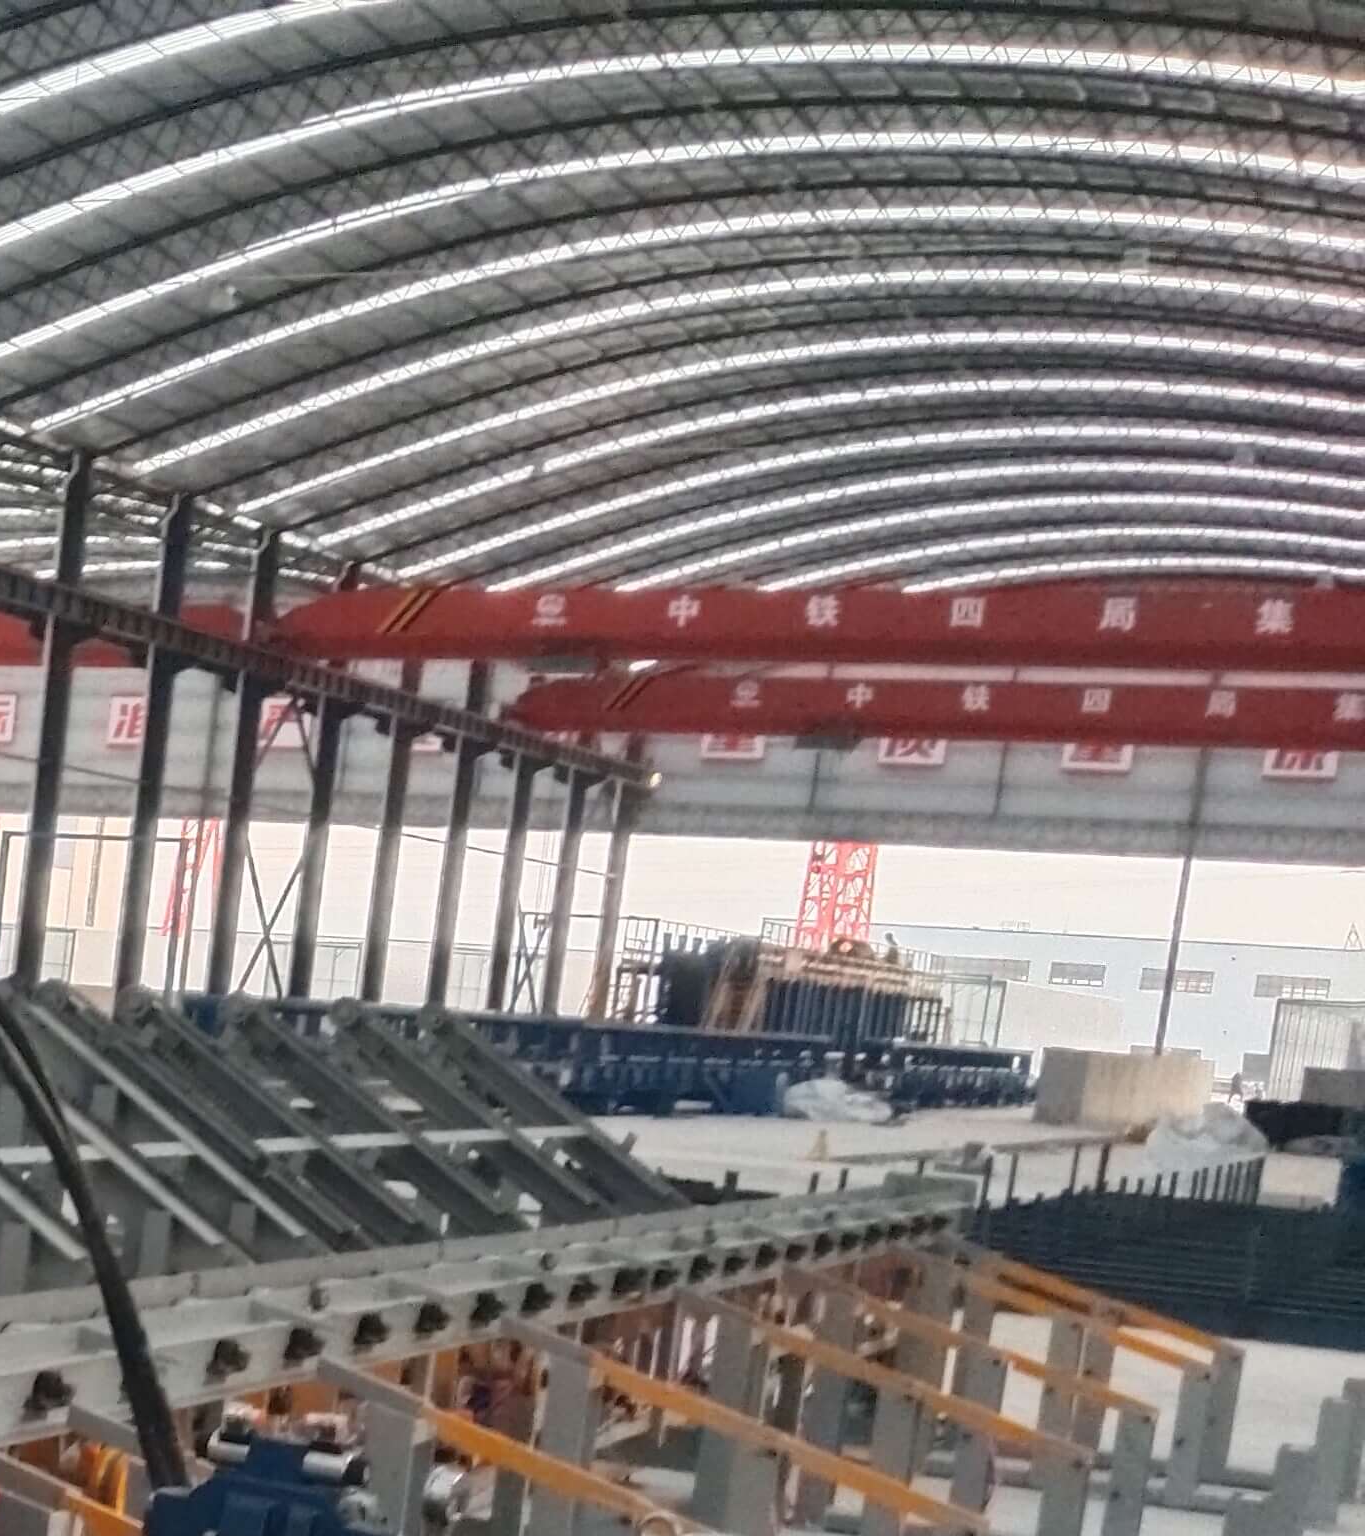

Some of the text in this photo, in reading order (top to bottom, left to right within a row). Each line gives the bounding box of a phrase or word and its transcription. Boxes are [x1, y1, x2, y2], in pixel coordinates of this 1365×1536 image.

[668, 594, 1295, 636] 中铁四局集
